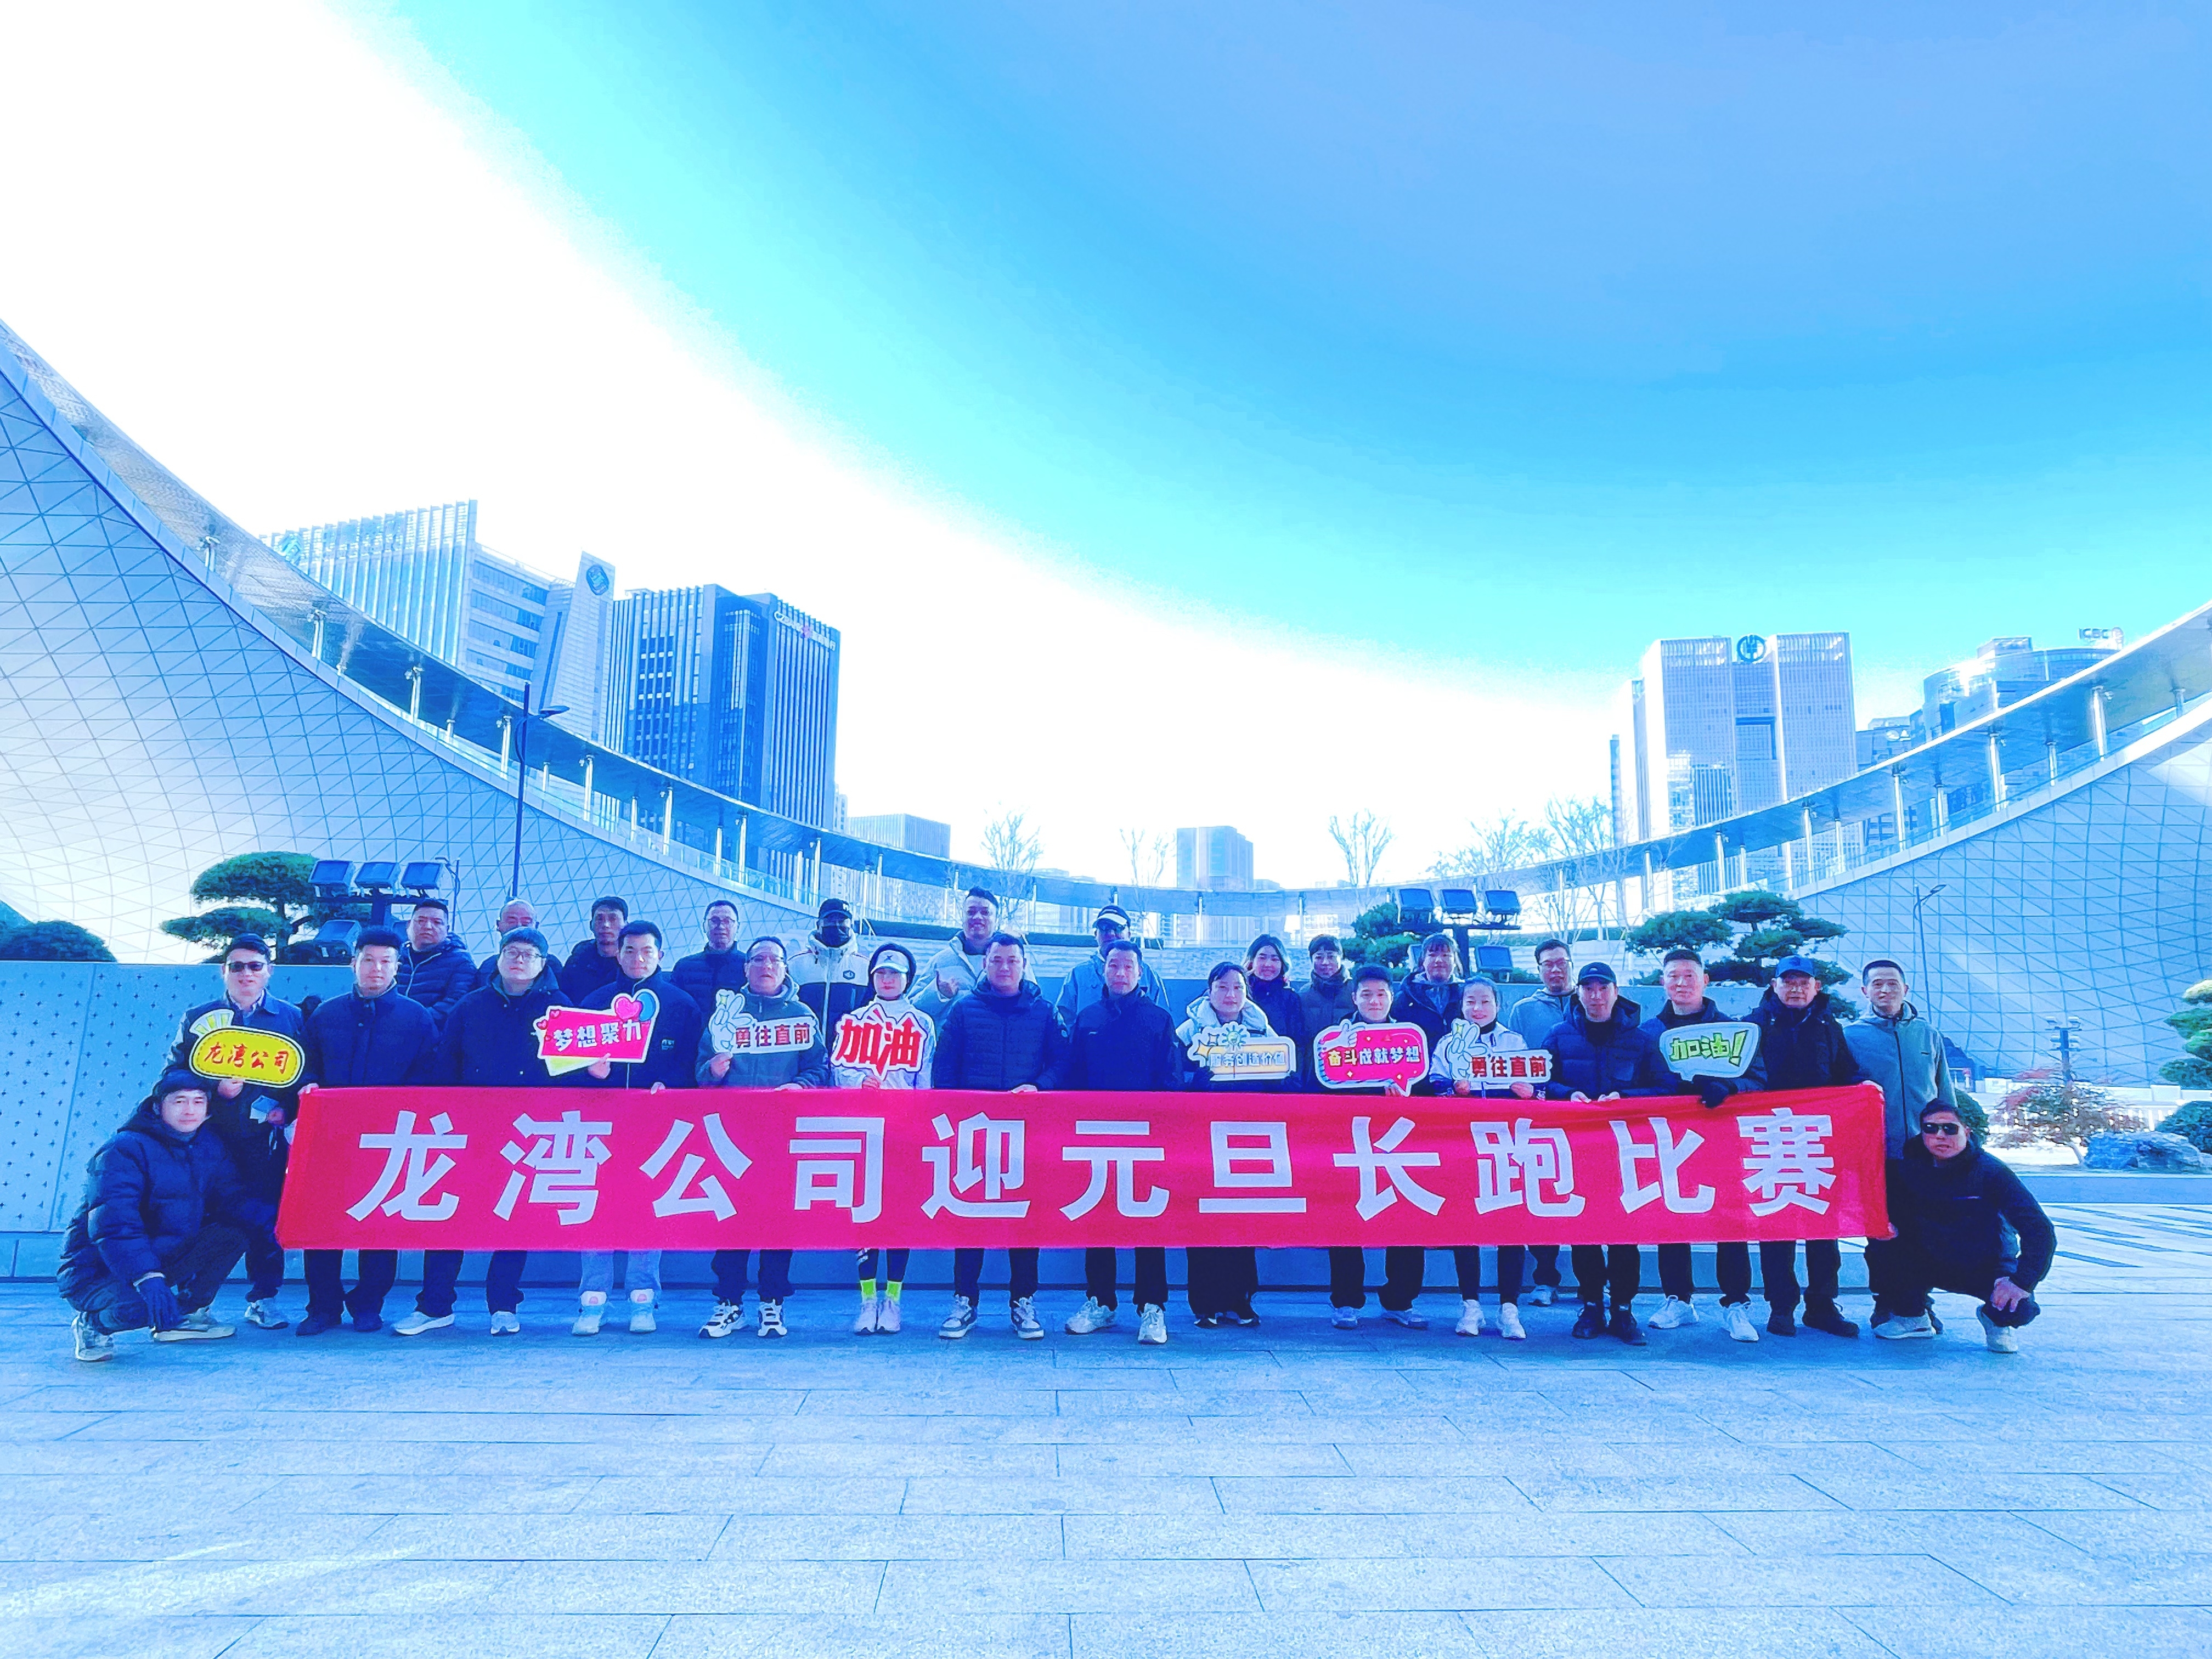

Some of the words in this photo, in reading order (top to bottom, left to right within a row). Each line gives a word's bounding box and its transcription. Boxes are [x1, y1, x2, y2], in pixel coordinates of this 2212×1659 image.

[2079, 628, 2110, 639] ICBC
[553, 1019, 642, 1052] 梦想聚力
[735, 1023, 810, 1048] 勇往直前
[835, 1017, 923, 1076] 加油
[204, 1042, 289, 1074] 龙湾公司
[1328, 1046, 1421, 1066] 奋斗成就梦想
[1471, 1056, 1547, 1078] 勇往直前
[346, 1108, 1837, 1226] 龙湾公司迎元旦长跑比赛
